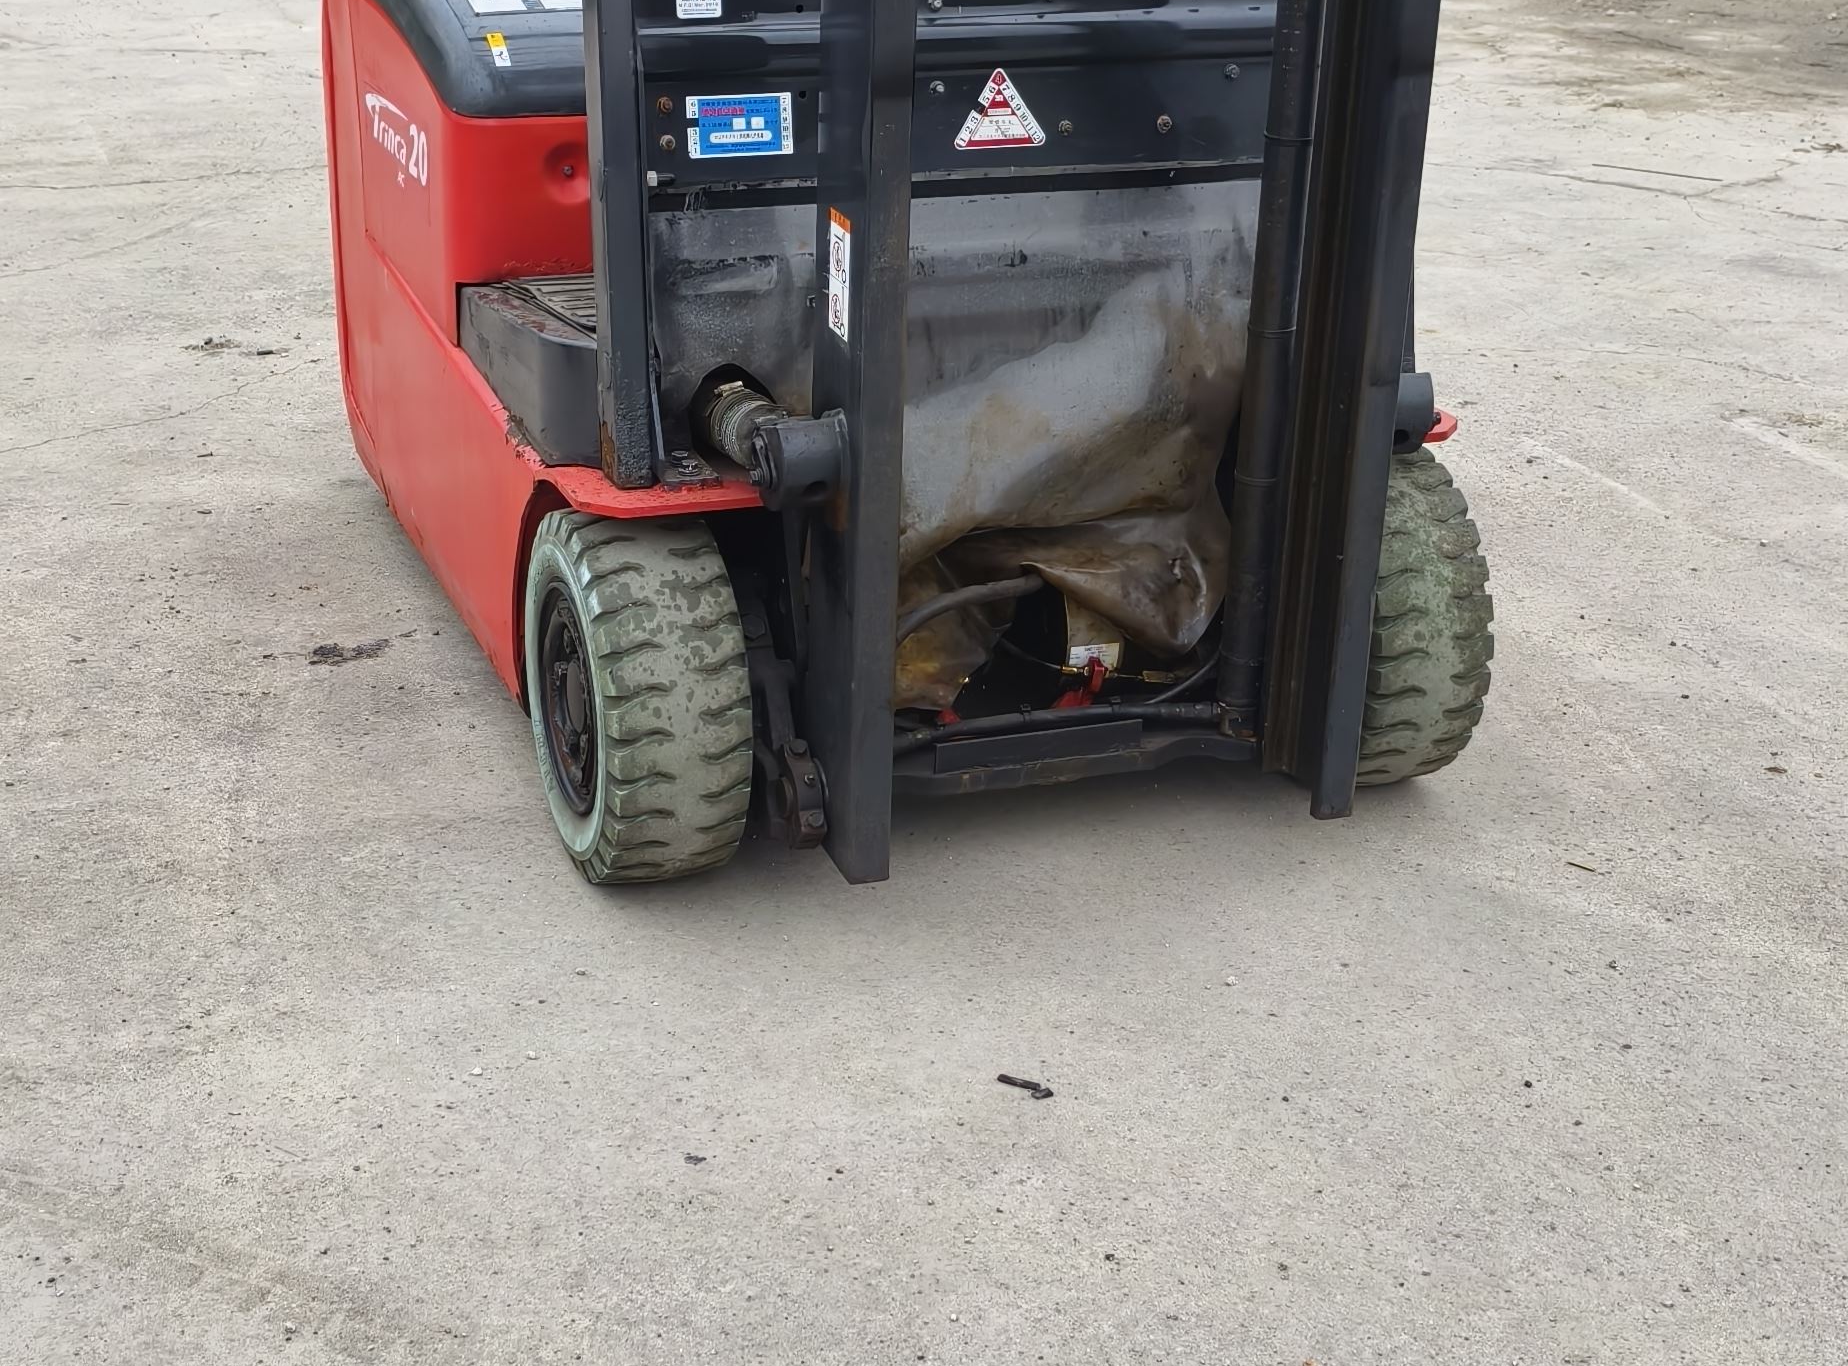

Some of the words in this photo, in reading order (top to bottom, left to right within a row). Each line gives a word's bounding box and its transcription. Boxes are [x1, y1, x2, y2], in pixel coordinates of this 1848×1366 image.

[1002, 84, 1010, 92] 7
[983, 95, 990, 104] 5
[1014, 103, 1021, 111] 9
[971, 116, 979, 124] 3
[1020, 113, 1029, 122] 10
[965, 126, 972, 134] 2
[1025, 122, 1034, 131] 11
[365, 93, 409, 167] Trinca
[408, 123, 428, 186] 20
[1031, 131, 1041, 142] 12
